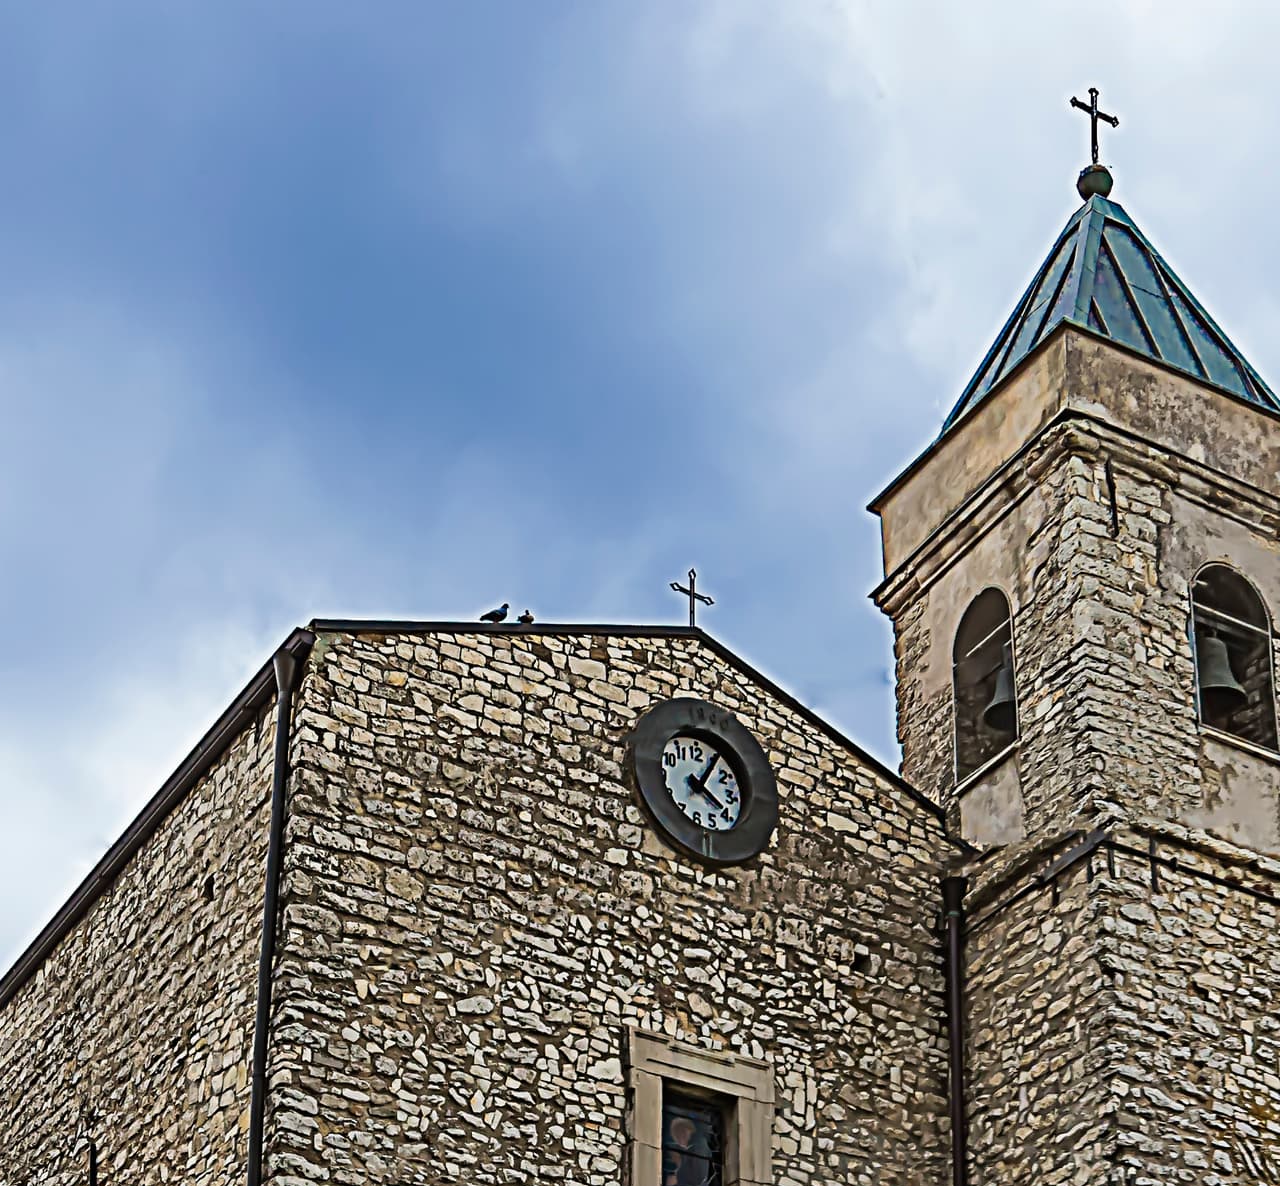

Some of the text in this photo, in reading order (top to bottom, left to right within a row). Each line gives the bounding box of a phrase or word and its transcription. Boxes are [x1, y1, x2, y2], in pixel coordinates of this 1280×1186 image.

[663, 752, 676, 768] 10
[675, 745, 686, 761] 11
[689, 746, 703, 763] 12
[719, 770, 728, 785] 2
[708, 813, 717, 828] 5
[720, 807, 729, 822] 4
